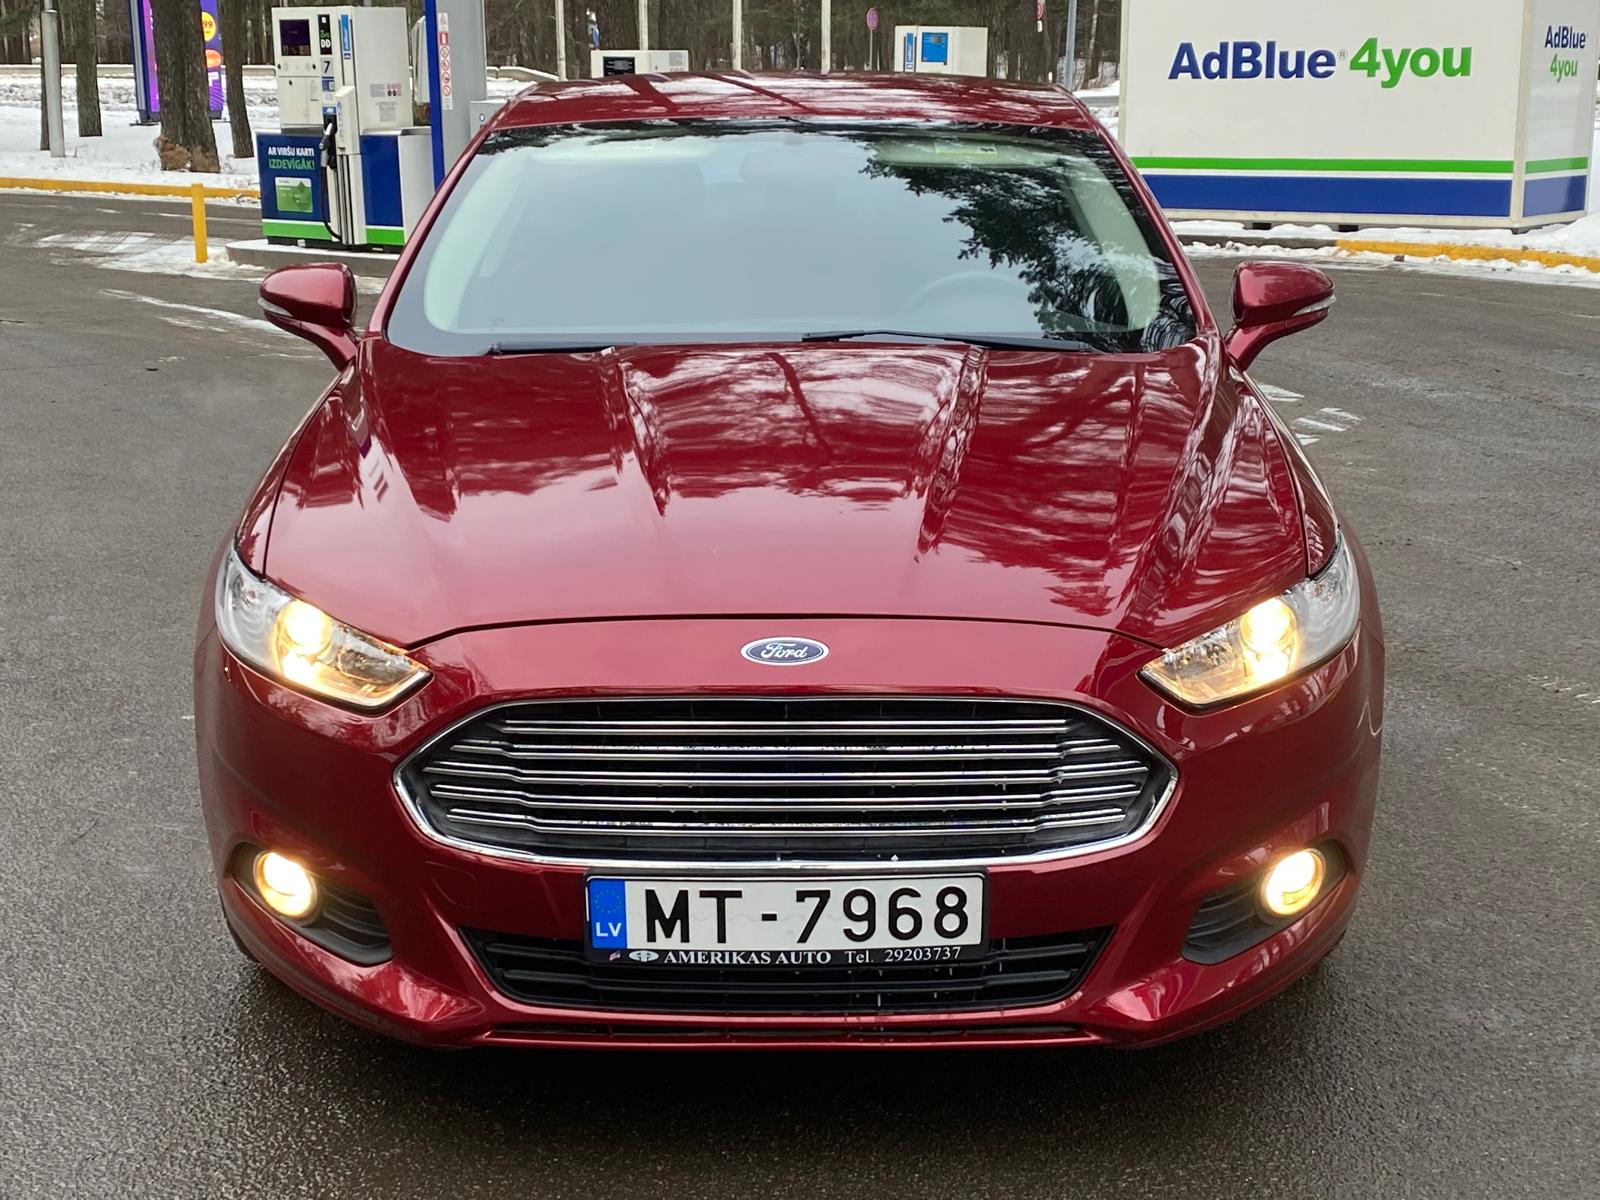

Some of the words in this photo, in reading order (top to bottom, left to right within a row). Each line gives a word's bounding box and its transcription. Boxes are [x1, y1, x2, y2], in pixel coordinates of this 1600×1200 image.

[1544, 25, 1586, 49] AdBlue
[323, 60, 331, 74] 7
[1349, 37, 1473, 89] 4you
[1550, 53, 1578, 83] 4you
[268, 147, 278, 156] AR
[760, 642, 809, 659] Ford
[595, 922, 622, 937] LV
[663, 950, 771, 965] AMERIKAS
[775, 950, 832, 965] AUTO
[844, 950, 875, 963] Tel.
[884, 946, 961, 962] 29203737
